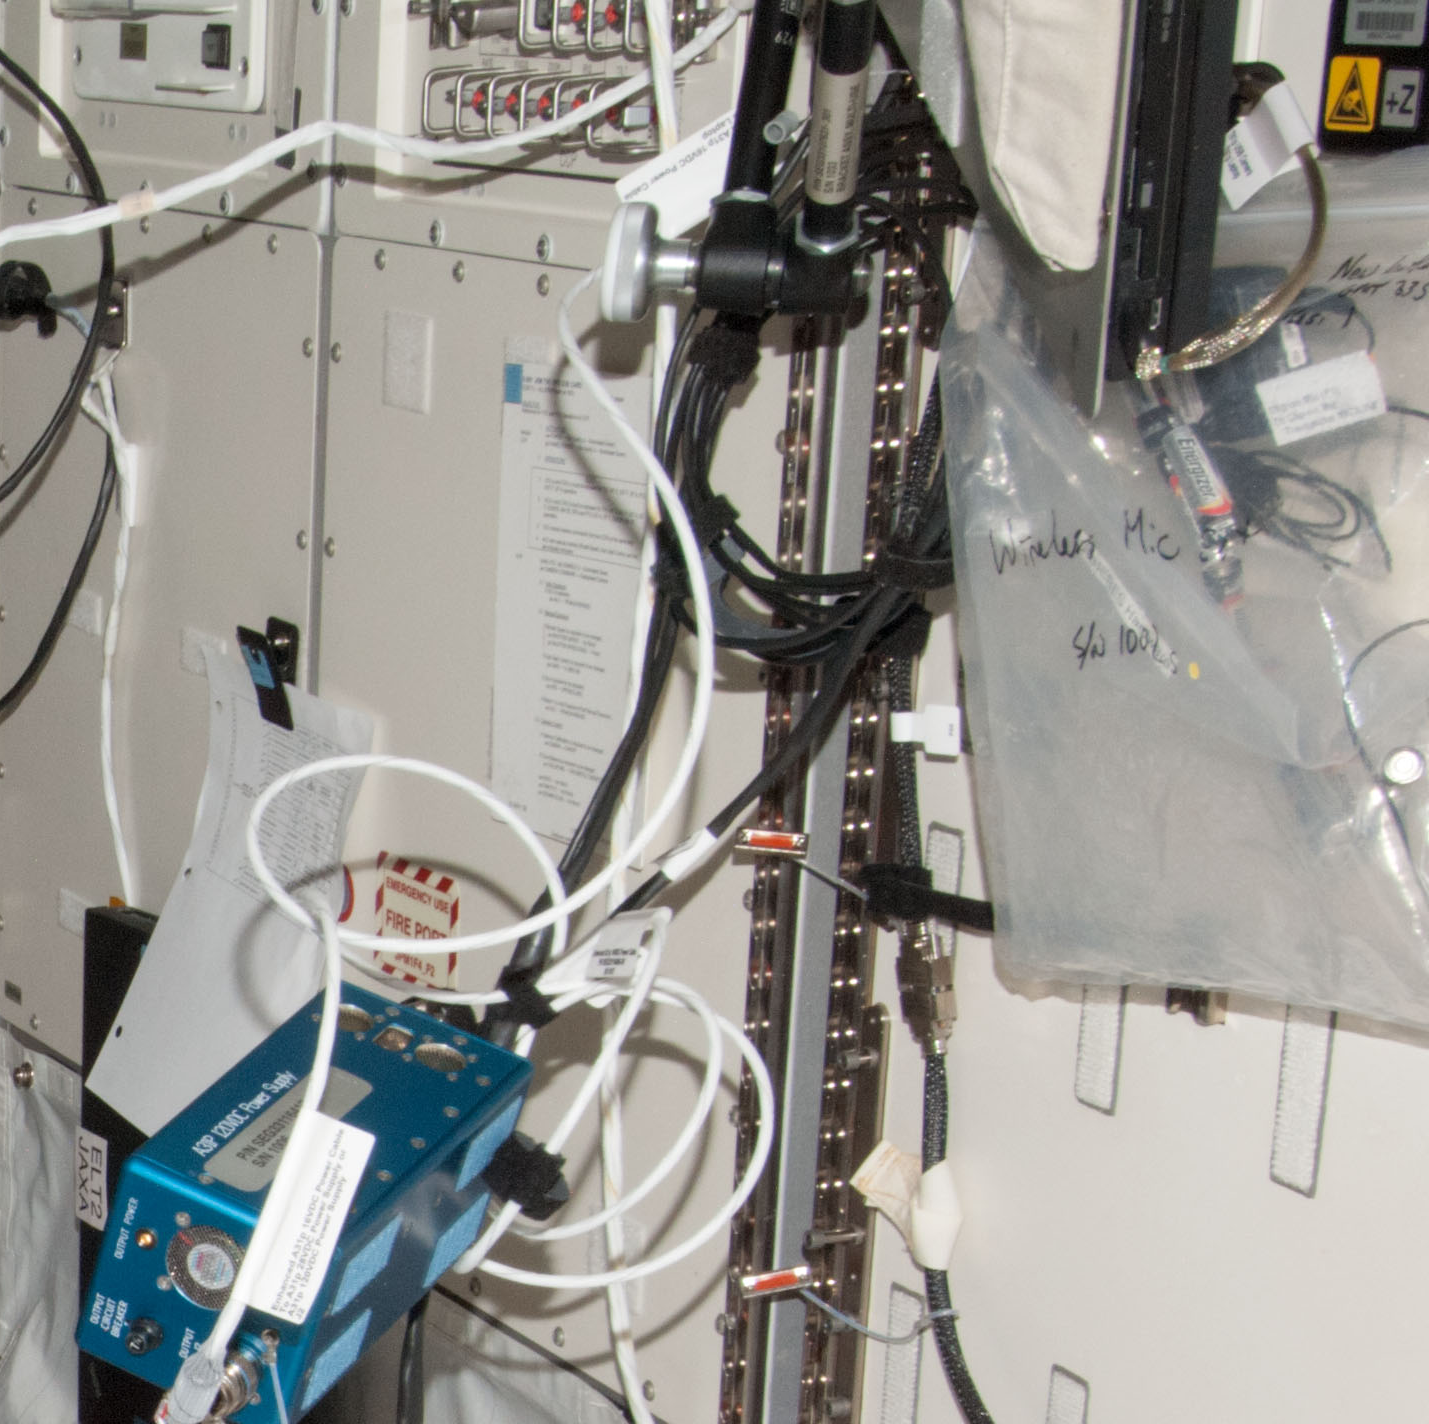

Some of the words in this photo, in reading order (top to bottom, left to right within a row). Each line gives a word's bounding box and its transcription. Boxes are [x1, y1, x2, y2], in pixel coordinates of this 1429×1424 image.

[1384, 83, 1416, 116] +Z
[700, 116, 732, 140] Laptop
[649, 162, 679, 186] Power
[1177, 437, 1216, 498] Energizer
[989, 508, 1096, 576] Wireless
[1124, 507, 1181, 561] Mic
[384, 876, 433, 906] EMERGENCY
[432, 897, 450, 914] USE
[382, 908, 414, 936] FIRE
[238, 1091, 272, 1114] Power
[262, 1070, 298, 1093] Supply
[79, 1136, 90, 1211] JAXA
[91, 1146, 103, 1220] ELT2
[114, 1228, 130, 1259] OUTPUT
[125, 1197, 139, 1227] POWER
[270, 1257, 296, 1311] Enhanced
[290, 1229, 306, 1258] A31p
[315, 1159, 333, 1193] Power
[328, 1127, 346, 1158] Cable
[278, 1298, 289, 1313] To
[284, 1270, 300, 1298] A31p
[309, 1199, 328, 1233] Power
[322, 1162, 342, 1199] Supply
[286, 1289, 302, 1317] A31p
[314, 1213, 333, 1246] Power
[327, 1175, 348, 1212] Supply
[90, 1293, 105, 1324] OUTPUT
[101, 1298, 116, 1331] CIRCUIT
[111, 1300, 128, 1338] BREAKER
[179, 1328, 195, 1358] OUTPUT
